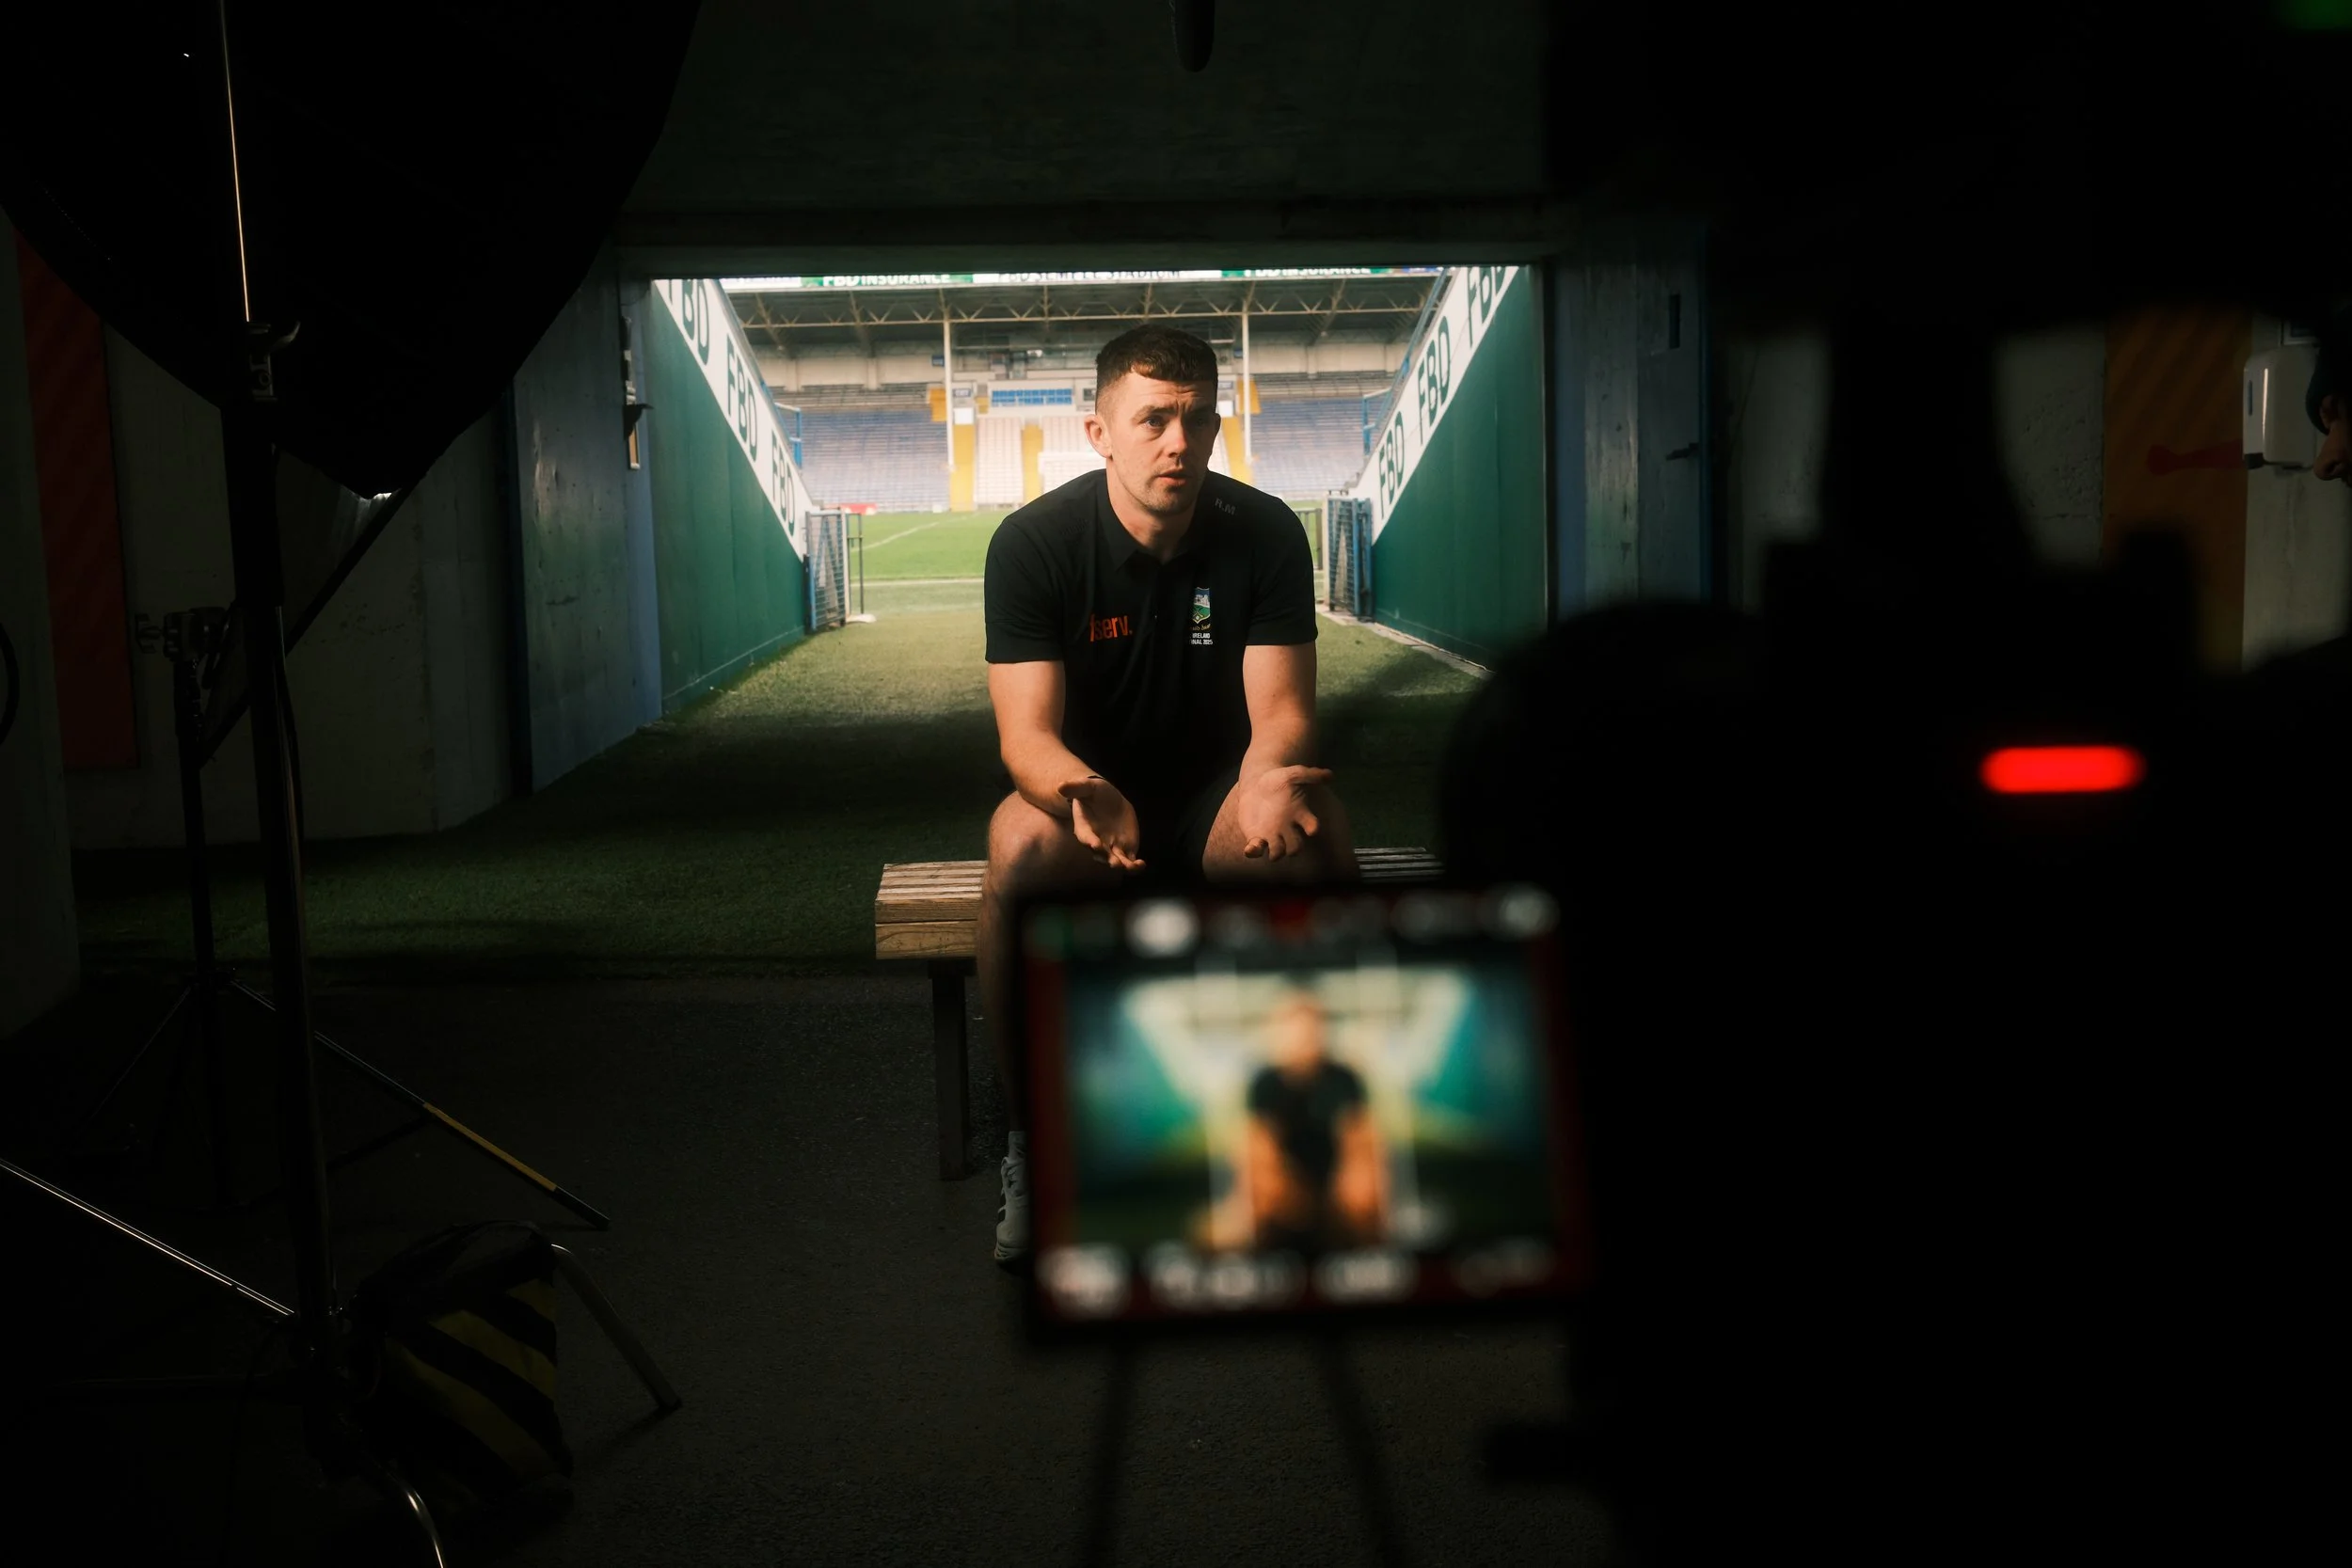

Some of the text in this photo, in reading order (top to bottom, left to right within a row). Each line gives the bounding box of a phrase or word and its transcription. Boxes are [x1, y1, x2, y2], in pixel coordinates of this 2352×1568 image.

[667, 278, 796, 536] BD FBD FBD
[1378, 266, 1505, 520] FBD FBD FB
